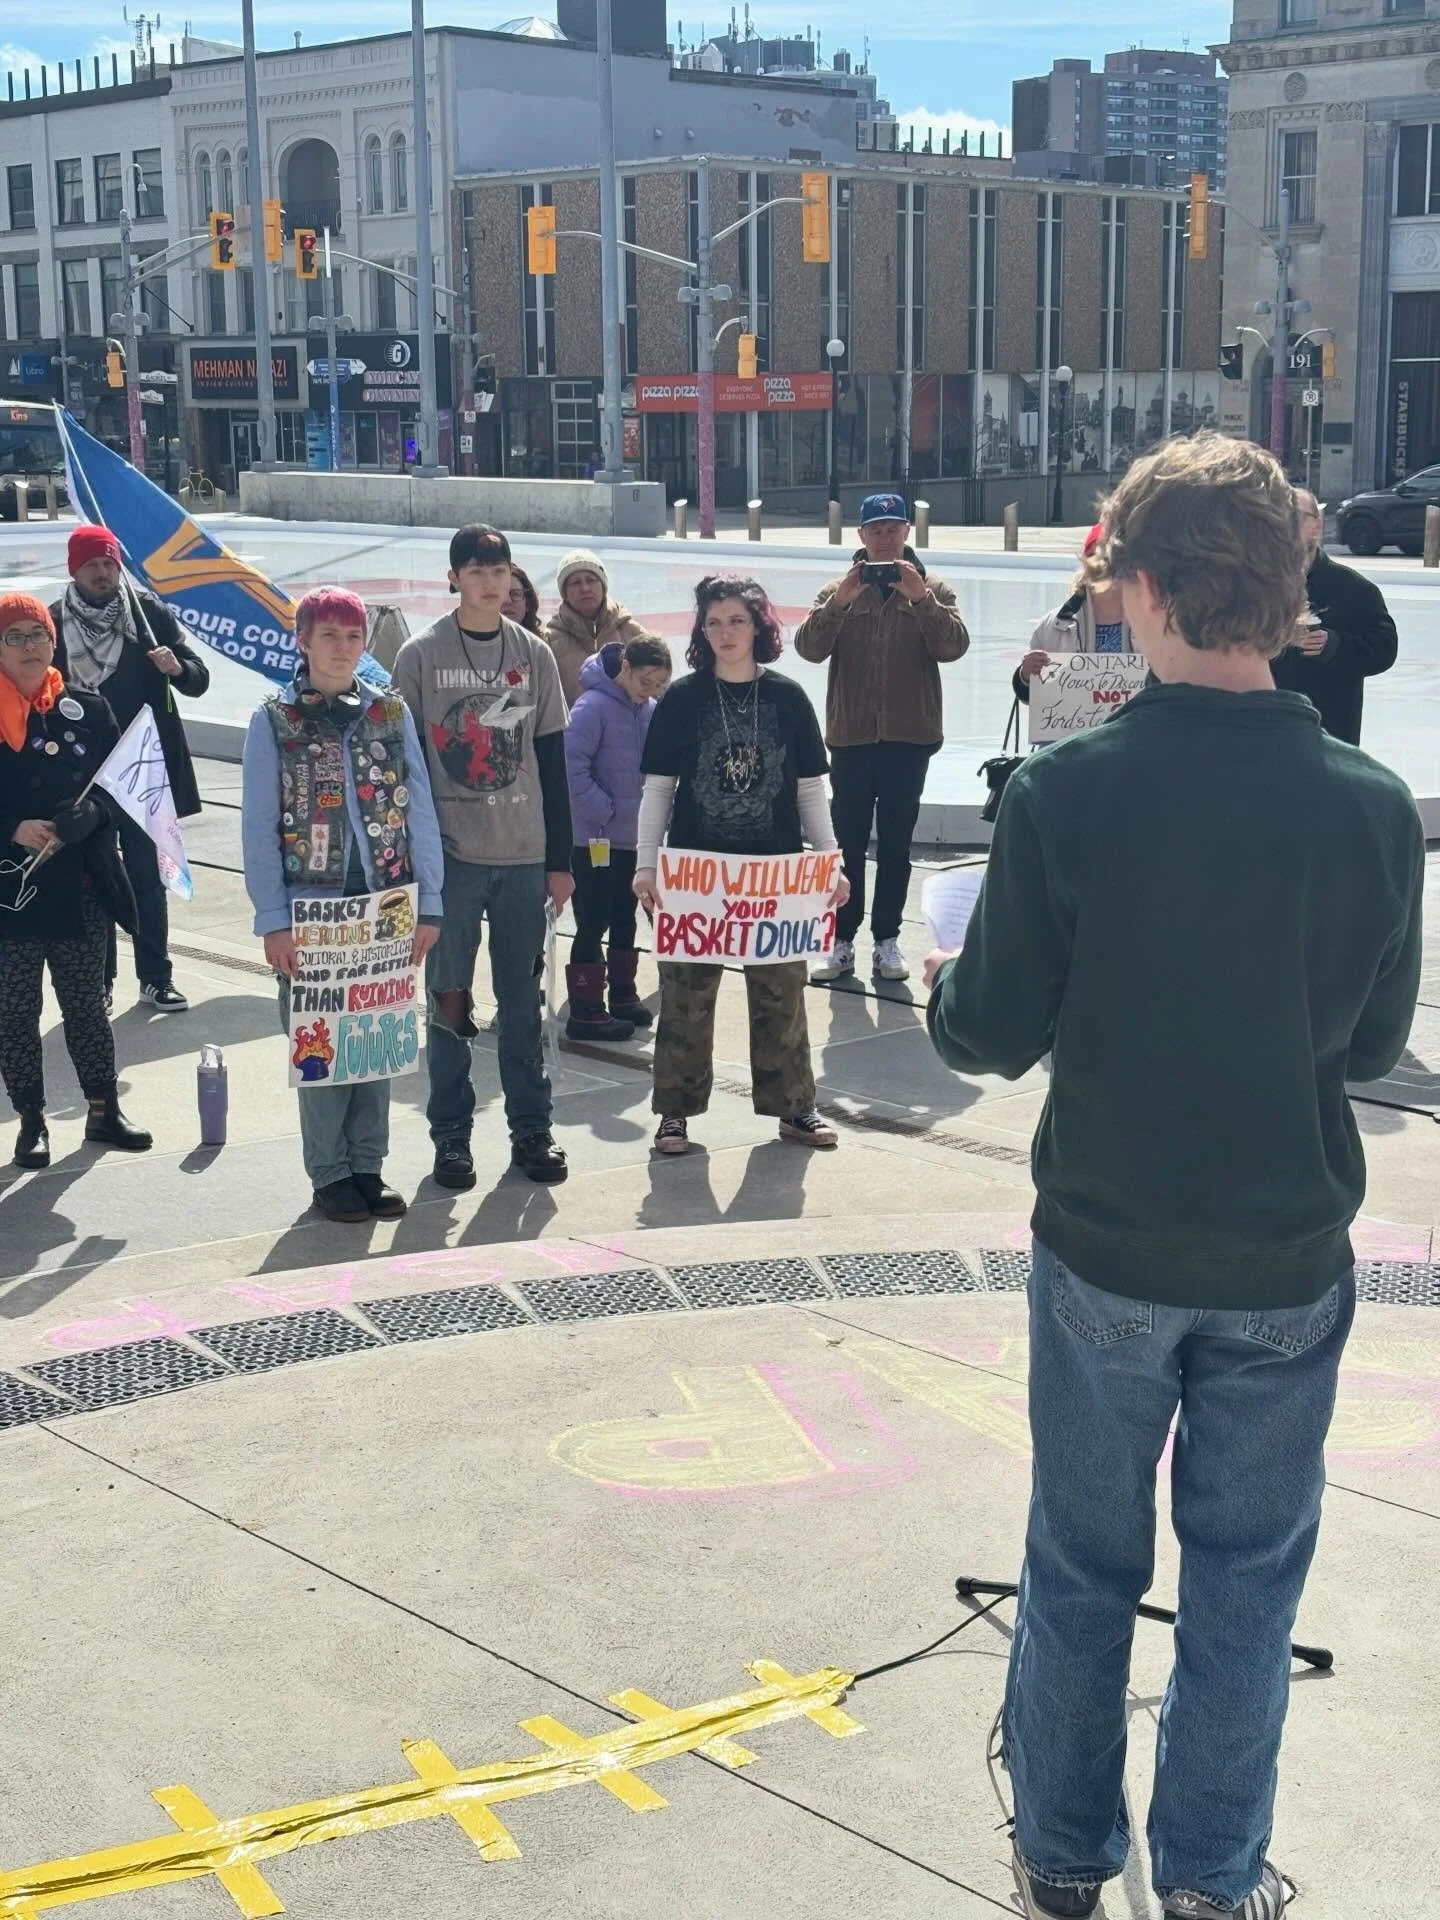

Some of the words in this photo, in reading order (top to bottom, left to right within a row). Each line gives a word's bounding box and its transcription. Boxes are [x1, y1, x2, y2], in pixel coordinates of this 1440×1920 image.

[193, 359, 243, 378] MEHMAN
[1288, 354, 1311, 369] 191
[642, 386, 671, 400] pizza
[764, 378, 791, 392] pizza
[768, 391, 795, 406] pizza
[1092, 690, 1131, 704] NOT
[661, 854, 717, 896] WHO
[721, 860, 781, 898] WILL
[784, 853, 840, 895] WEAVE
[294, 897, 371, 923] BASKET
[722, 899, 778, 920] YOUR
[656, 912, 754, 957] BASKET
[755, 911, 836, 958] DOUG?
[295, 969, 331, 982] AND
[336, 964, 369, 981] FAR
[292, 986, 345, 1012] THAN
[348, 974, 415, 1012] RUINING
[333, 1010, 419, 1082] FUTURES
